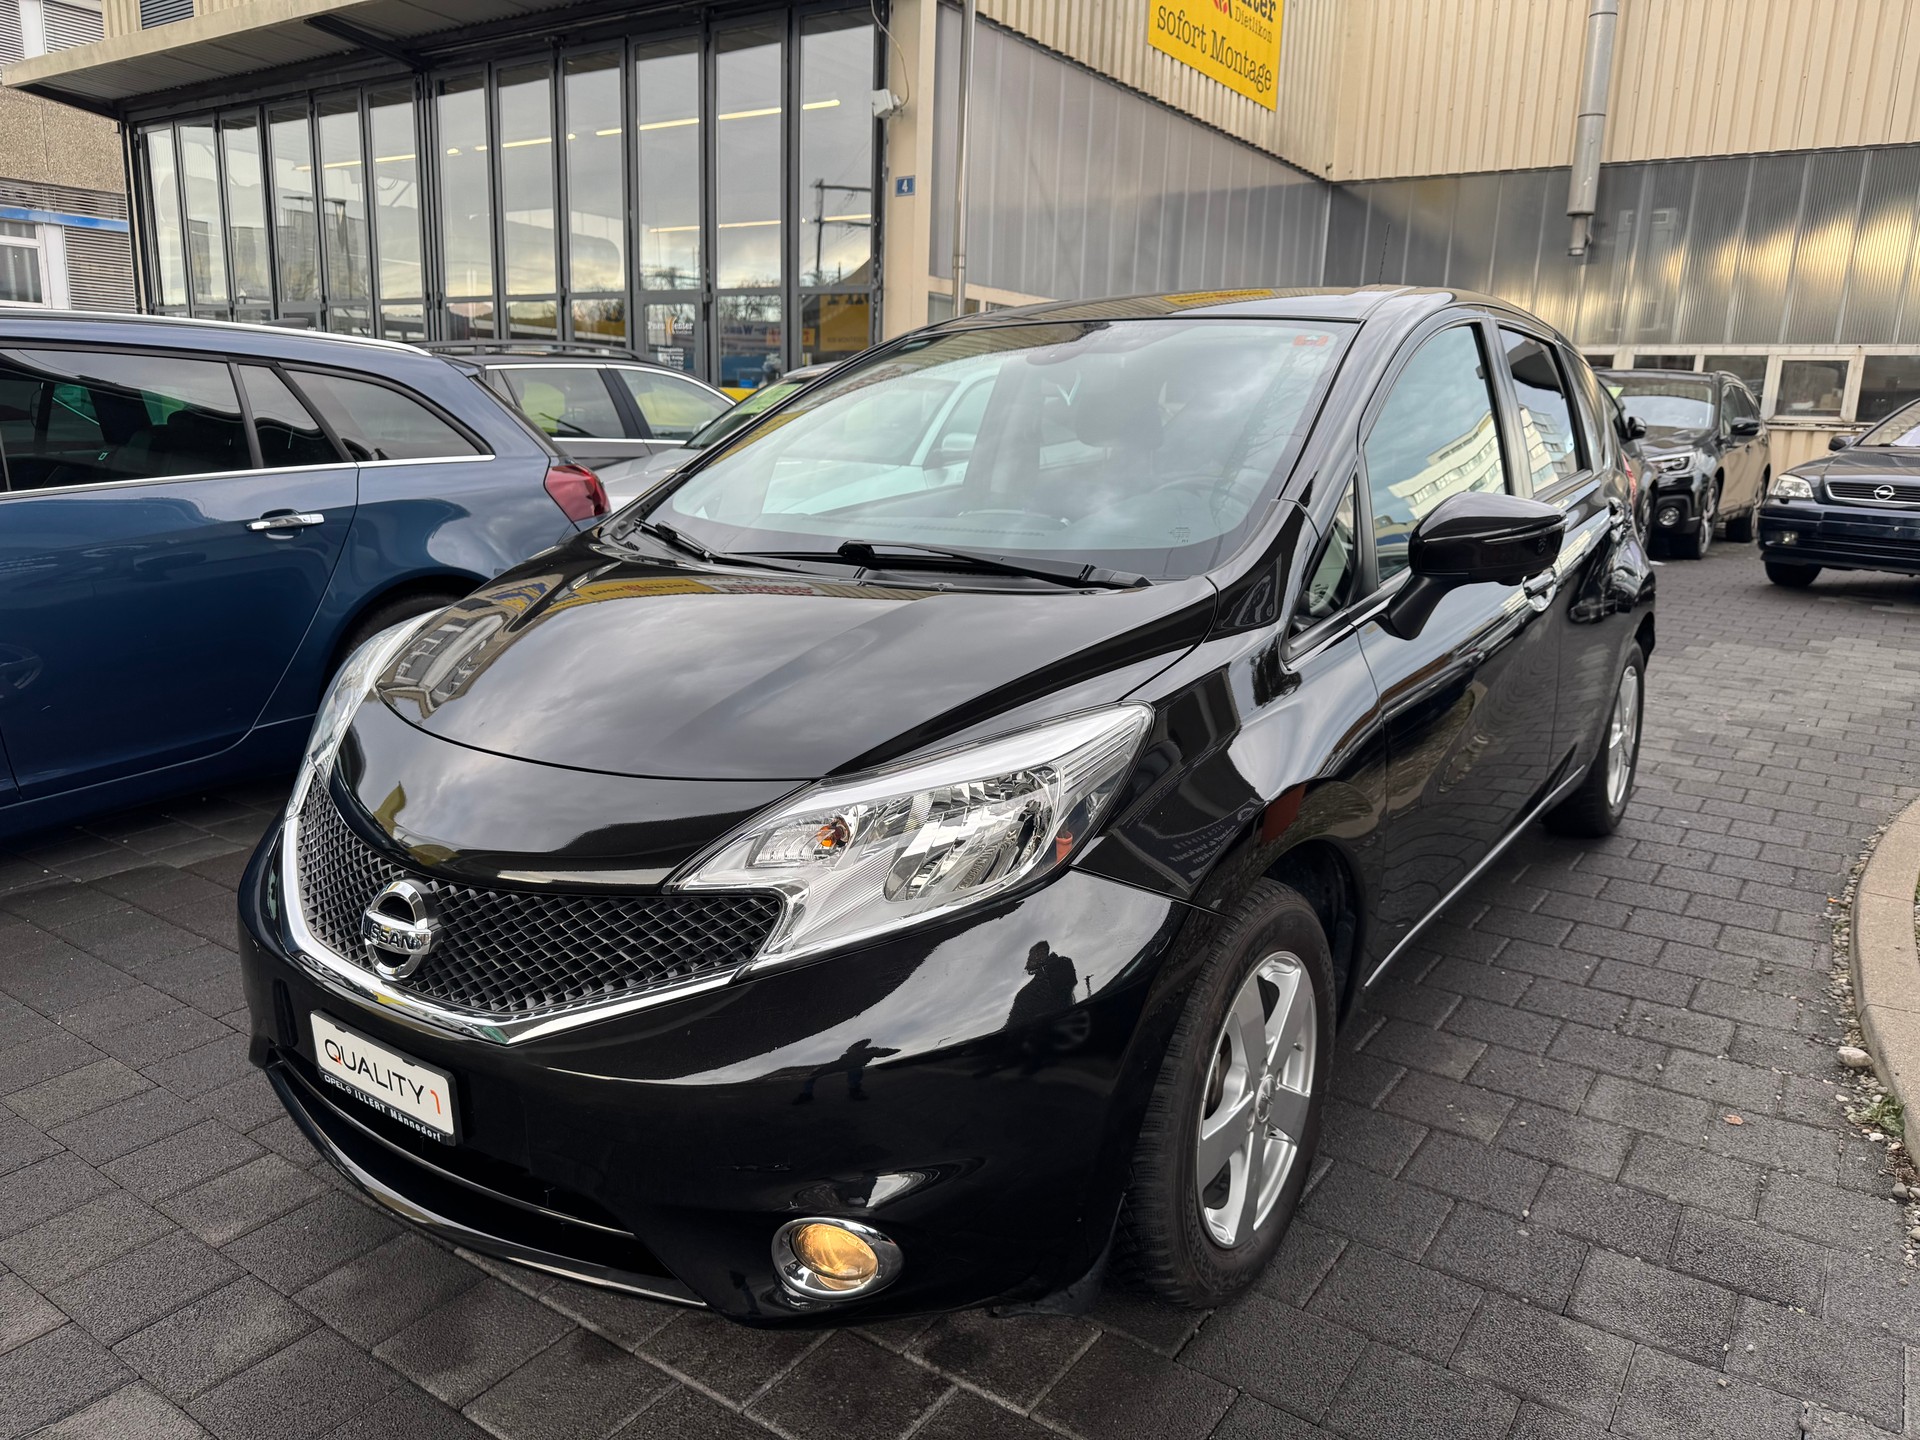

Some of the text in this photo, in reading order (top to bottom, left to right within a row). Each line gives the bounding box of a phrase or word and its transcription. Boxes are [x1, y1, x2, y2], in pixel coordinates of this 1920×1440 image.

[1157, 5, 1272, 93] sofort Montage
[1235, 6, 1272, 44] Dietlikon
[901, 179, 909, 193] 4
[325, 1038, 425, 1105] QUALITY
[354, 1089, 386, 1113] ILLERT
[390, 1109, 441, 1142] Männedorf
